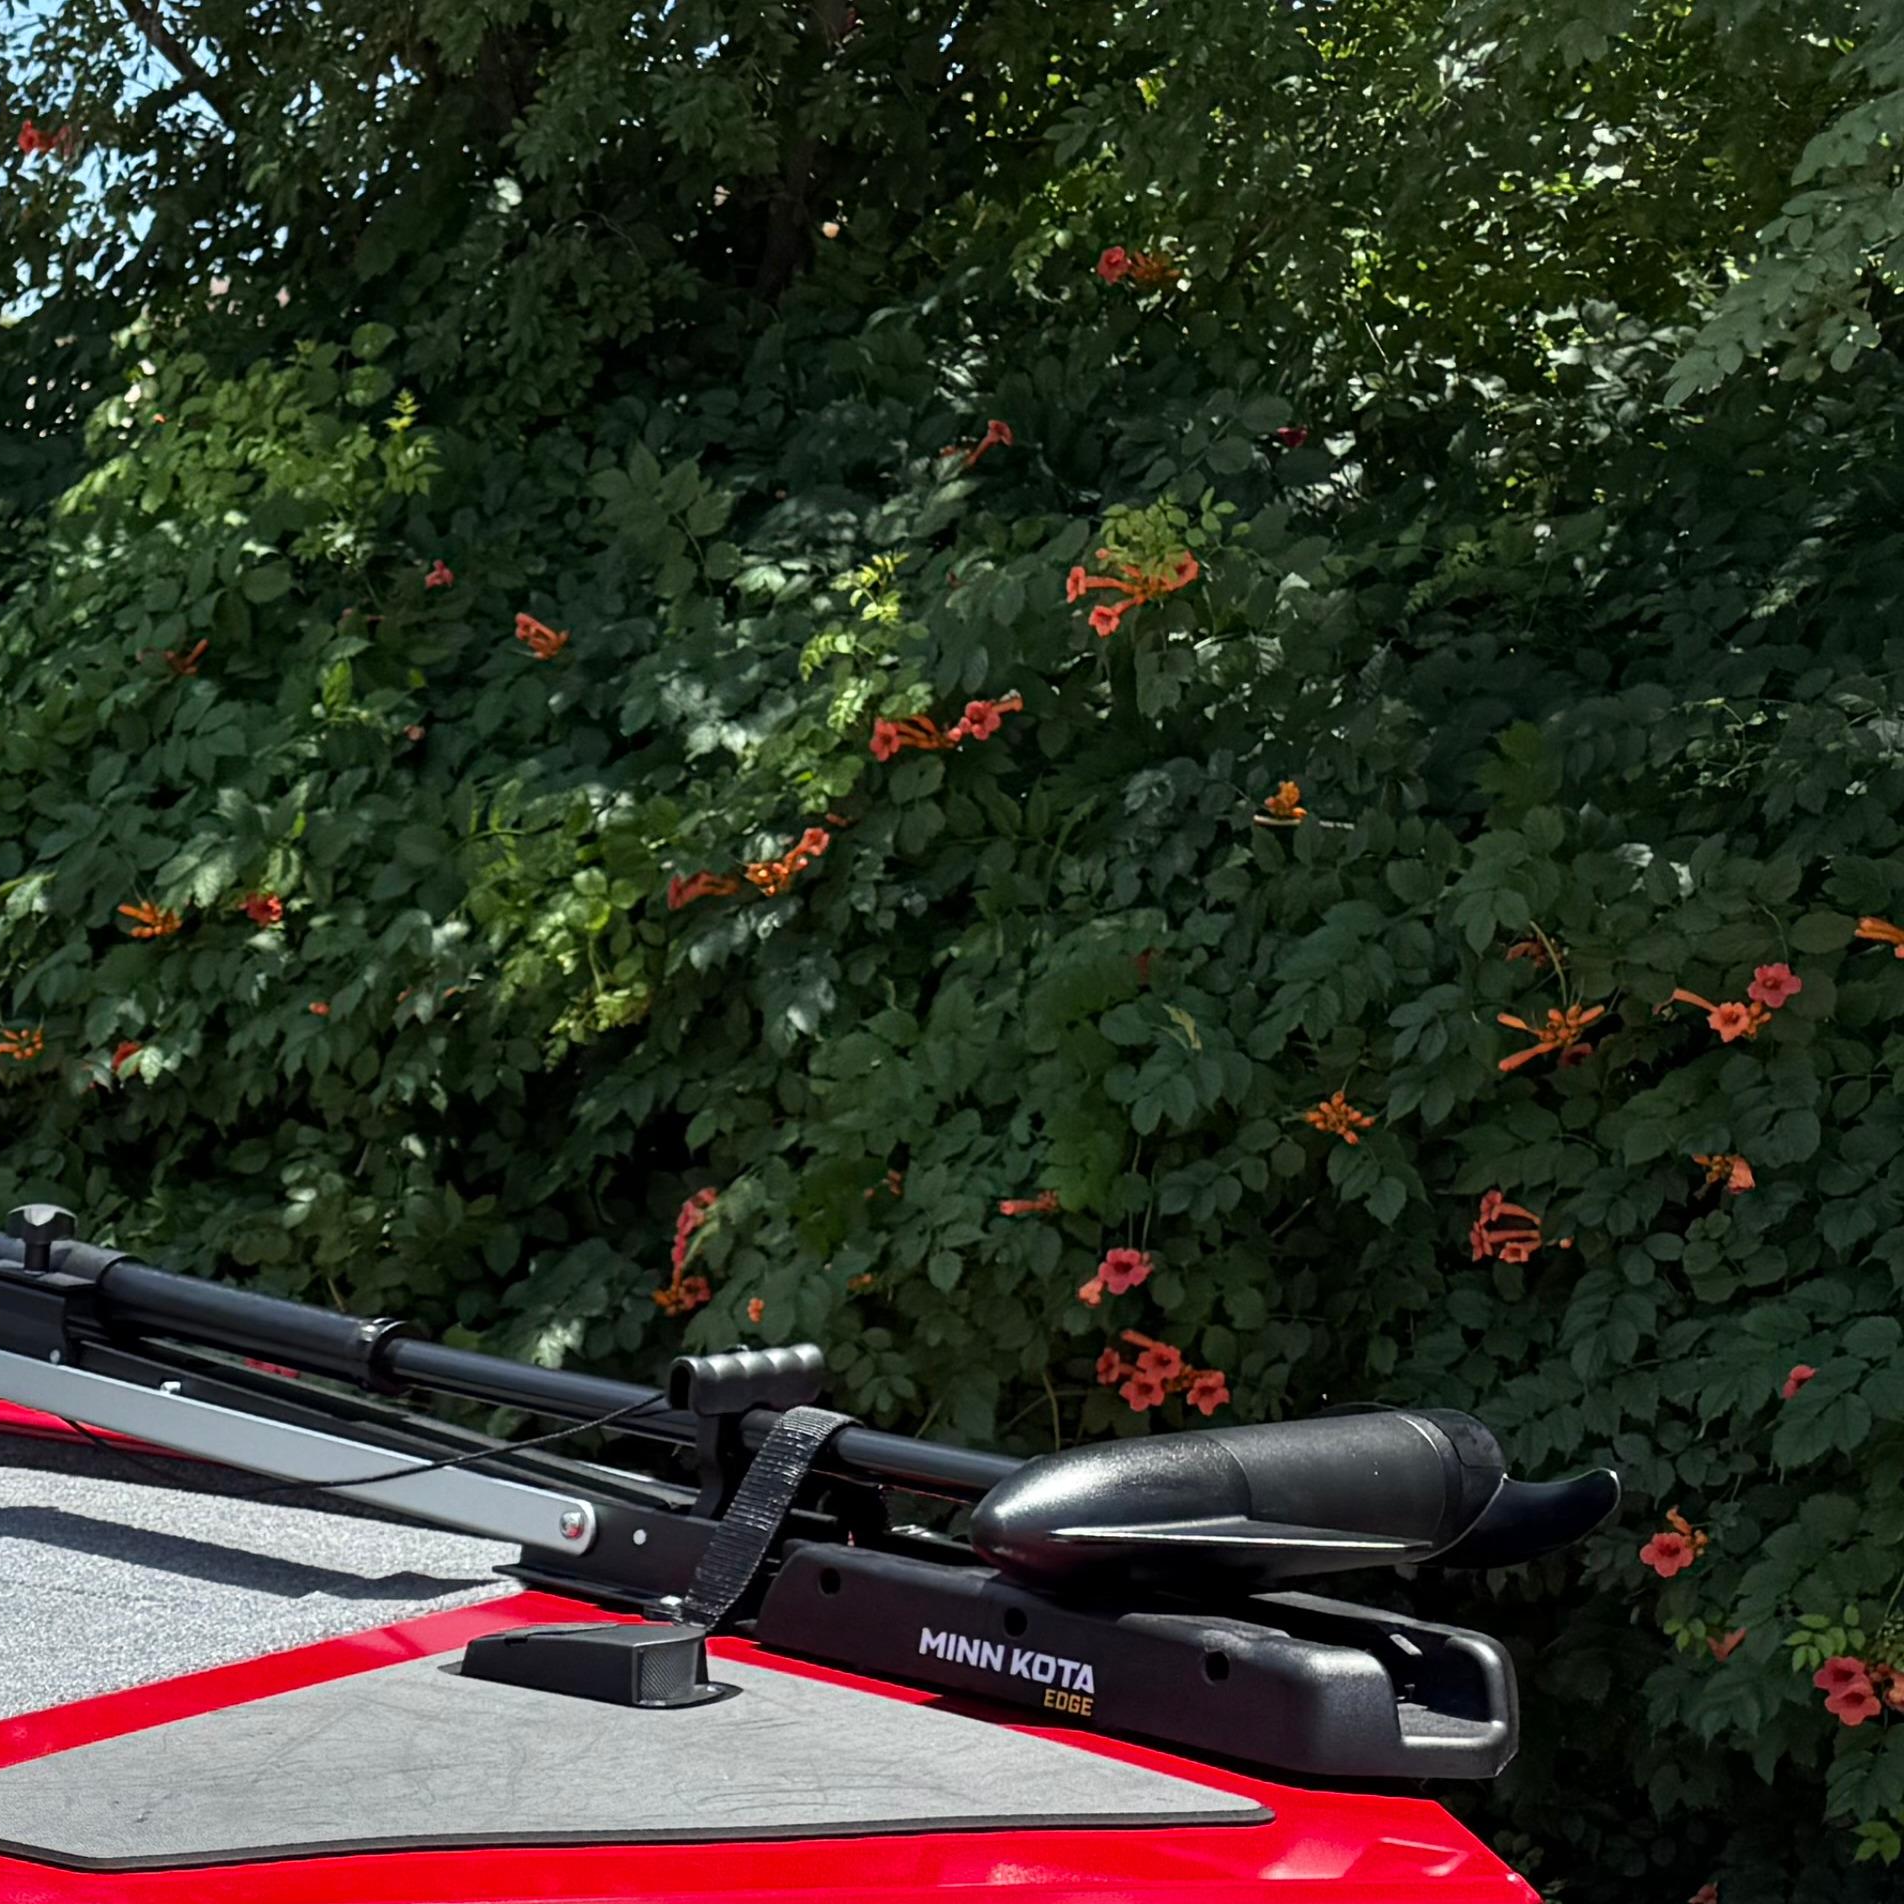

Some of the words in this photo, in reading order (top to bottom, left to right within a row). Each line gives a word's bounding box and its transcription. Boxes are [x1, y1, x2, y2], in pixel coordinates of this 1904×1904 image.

[918, 1627, 1005, 1672] MINN
[1009, 1648, 1095, 1694] KOTA
[1043, 1688, 1094, 1716] EDGE
